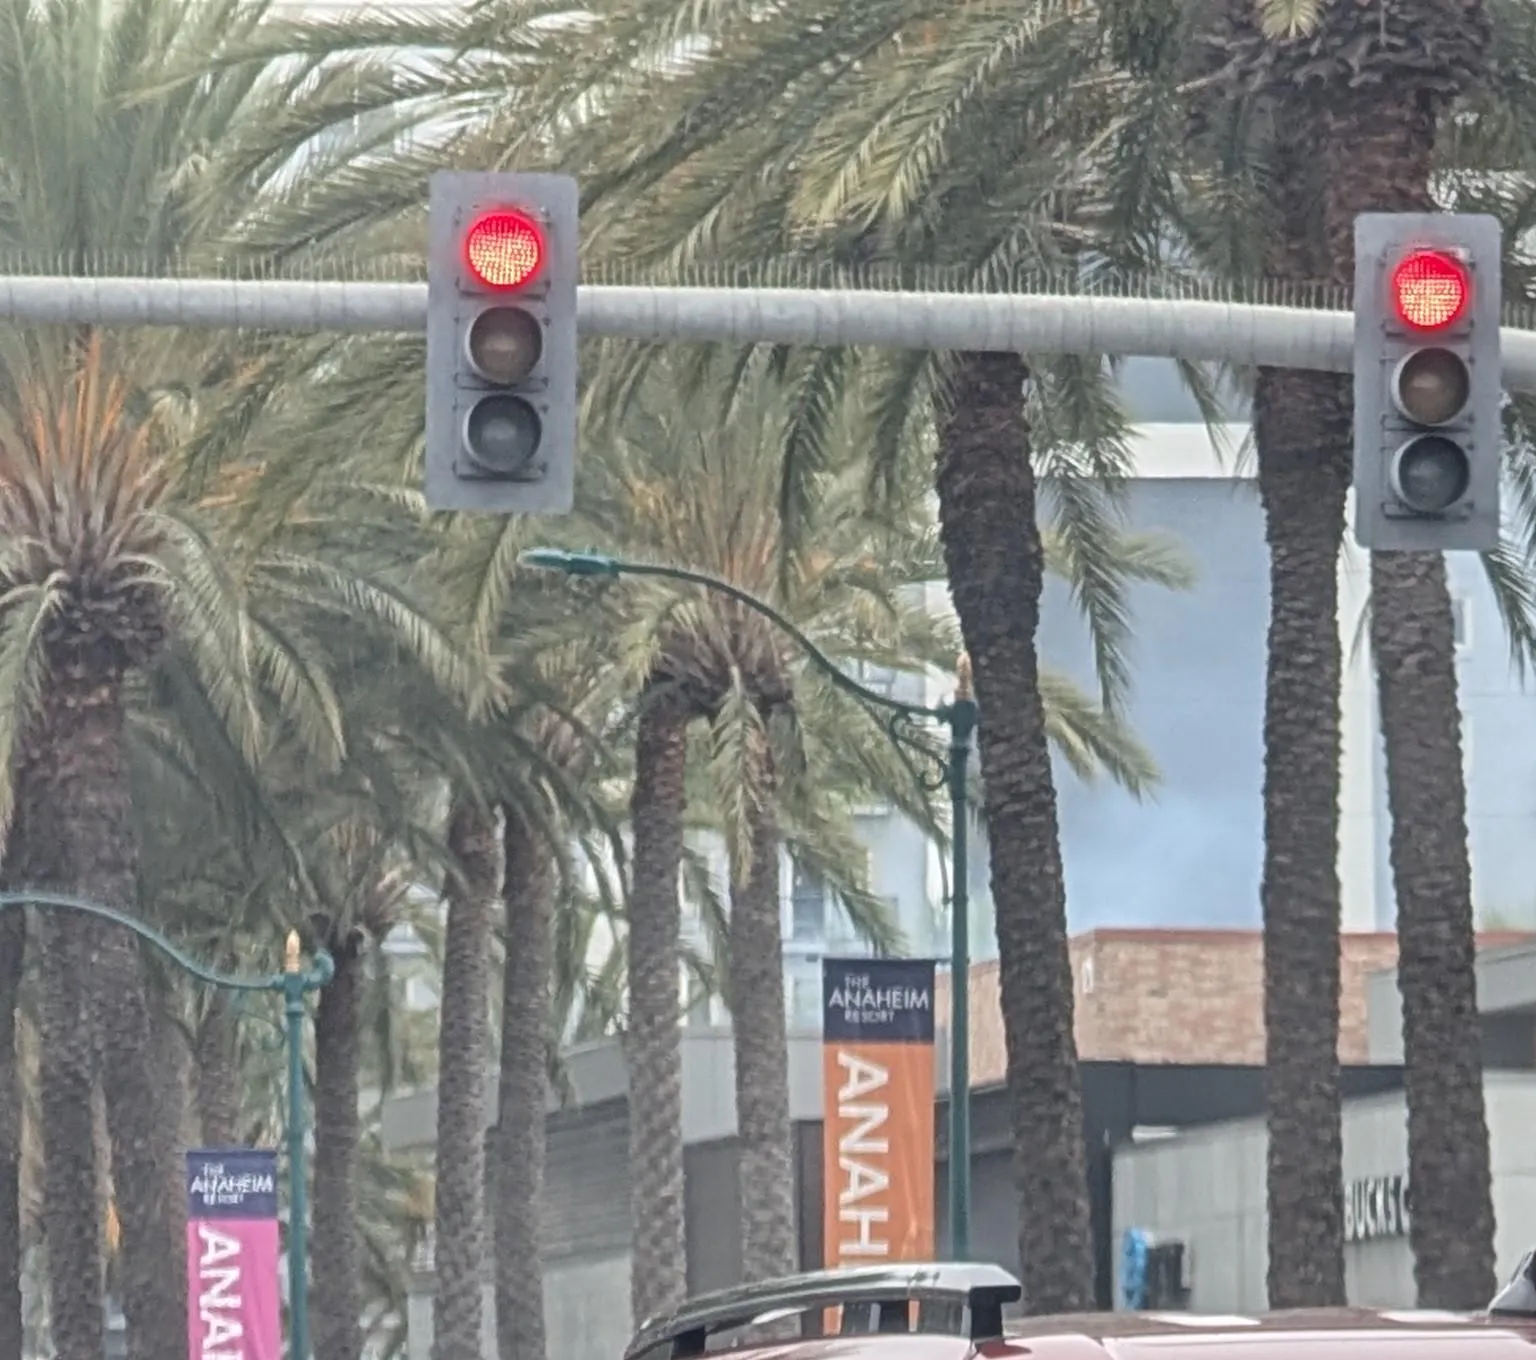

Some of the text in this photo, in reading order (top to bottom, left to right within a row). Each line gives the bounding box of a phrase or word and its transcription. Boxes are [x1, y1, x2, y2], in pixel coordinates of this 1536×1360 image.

[828, 987, 929, 1009] ANAHEIM
[837, 1050, 889, 1274] ANAH
[191, 1175, 273, 1194] ANAHEIM
